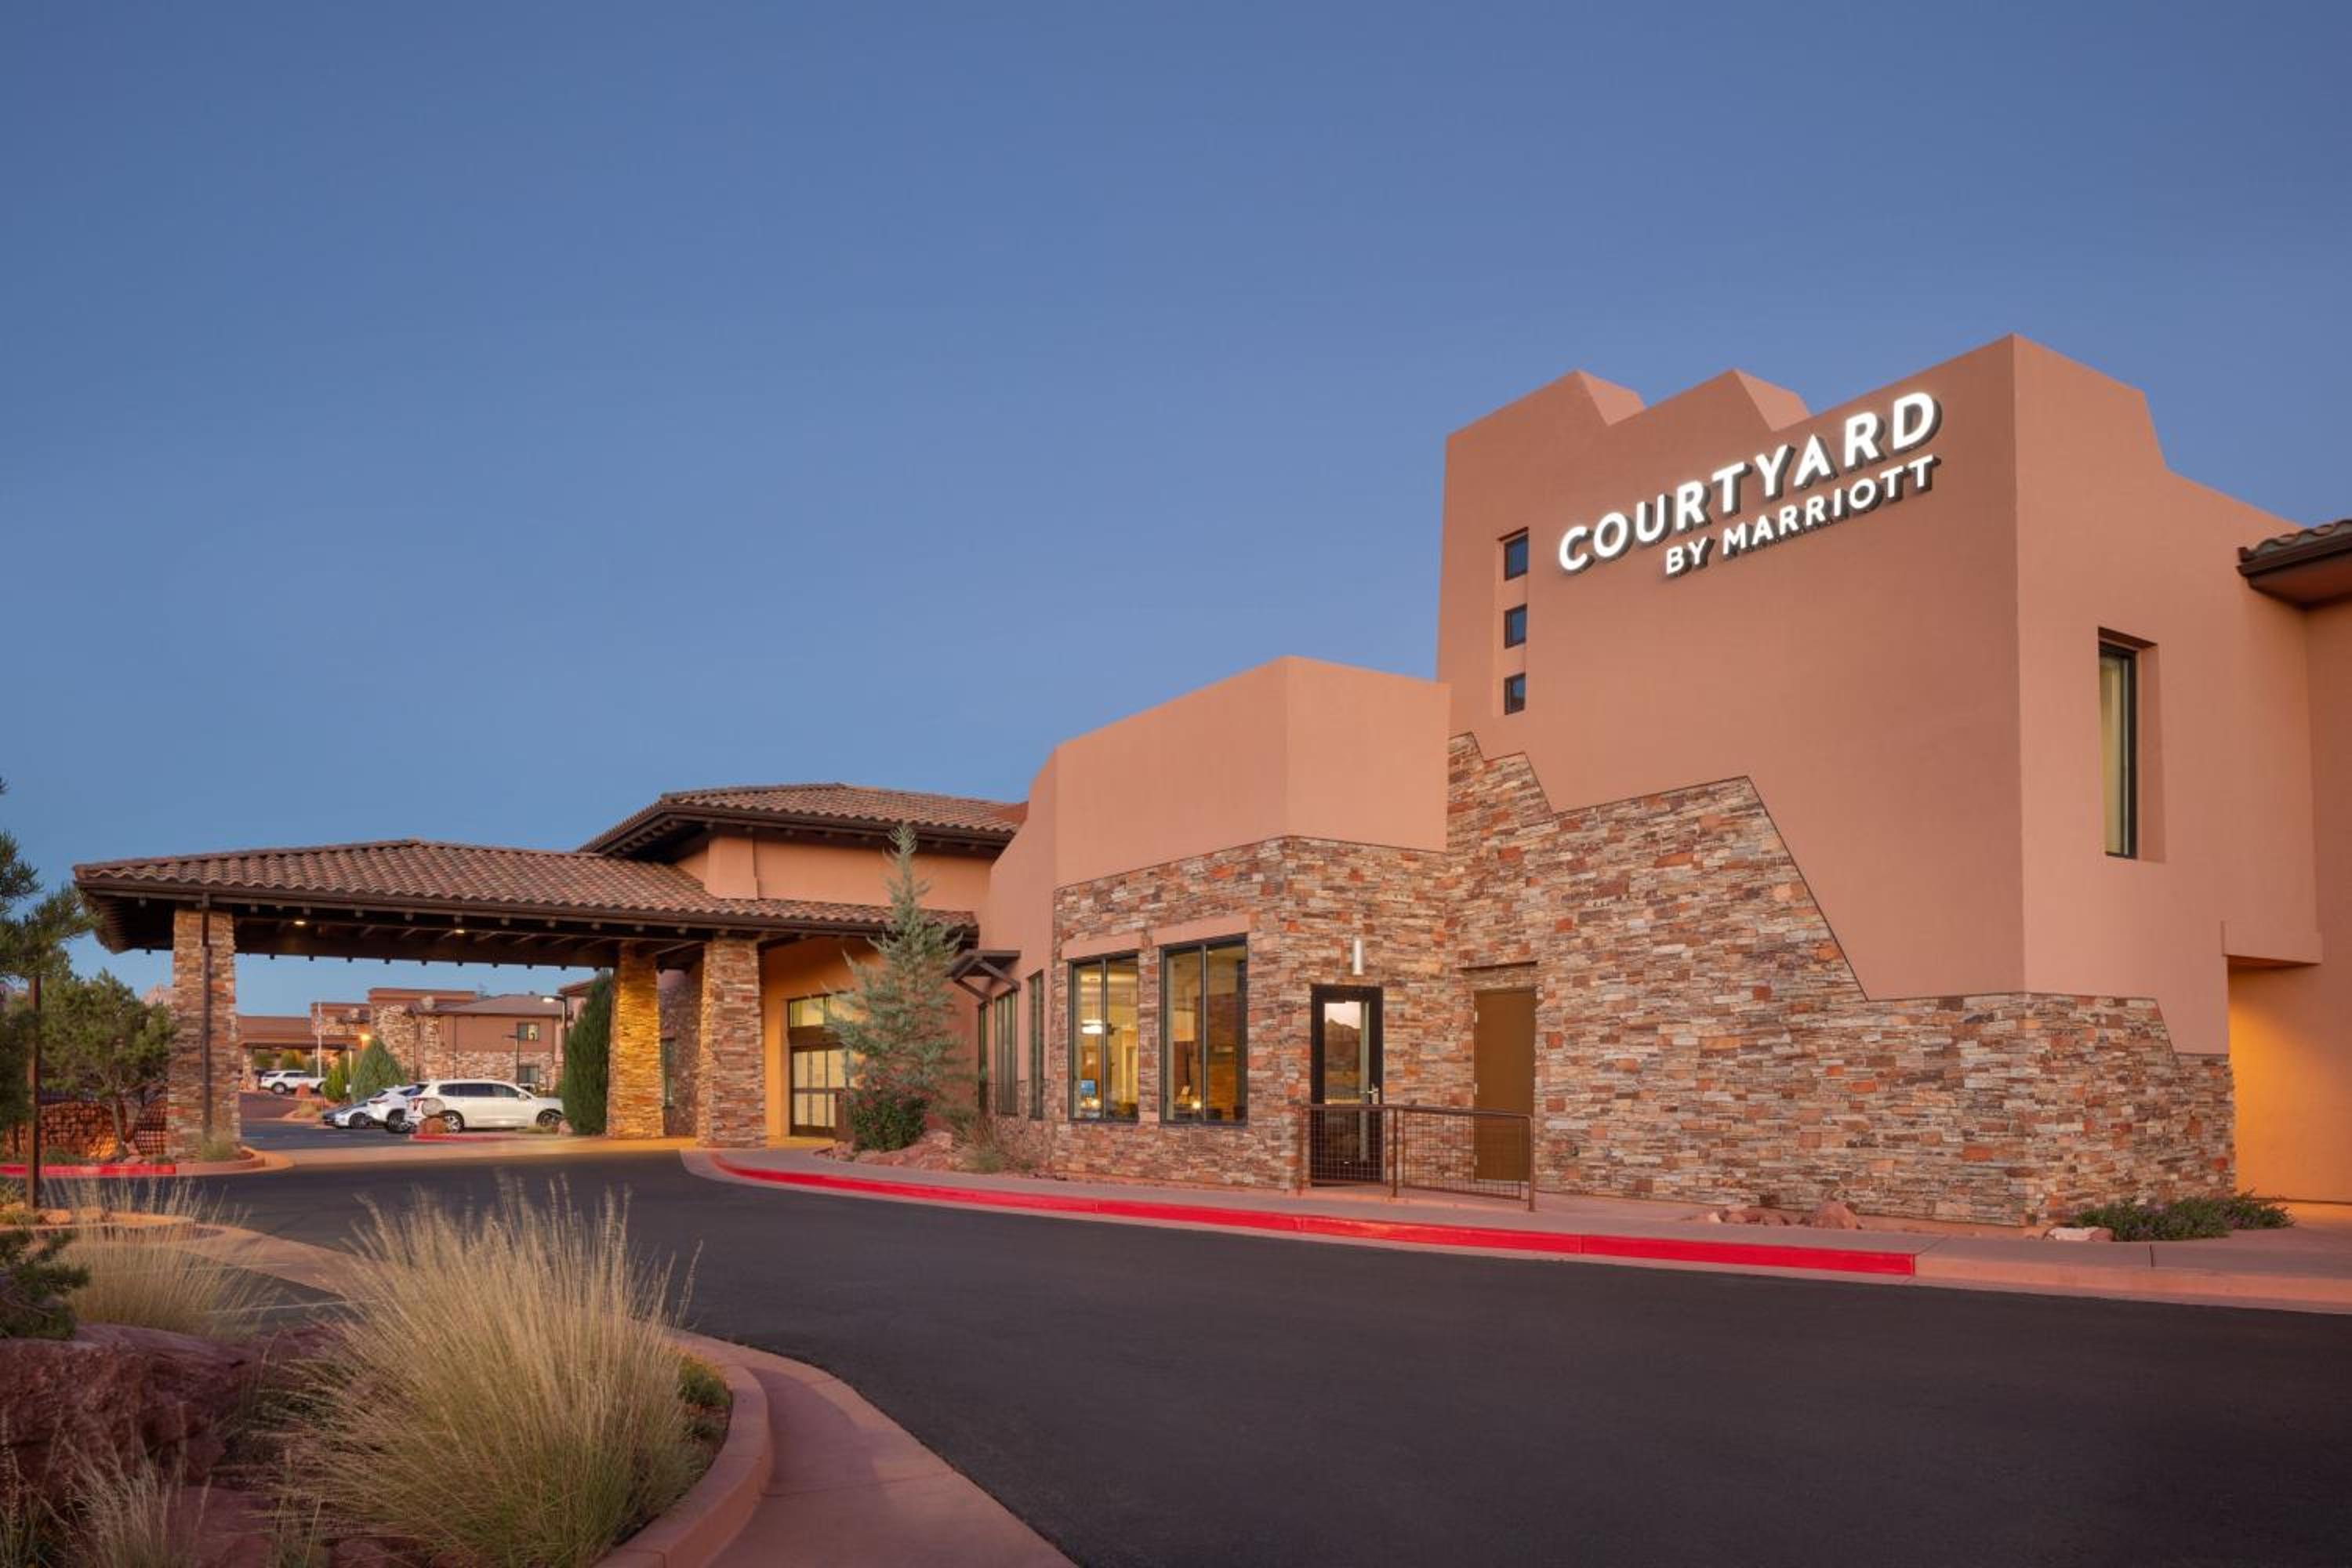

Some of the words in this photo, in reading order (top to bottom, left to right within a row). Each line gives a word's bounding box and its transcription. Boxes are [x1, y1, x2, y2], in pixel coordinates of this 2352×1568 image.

[1558, 391, 1940, 573] COURTYARD
[1664, 535, 1712, 576] BY
[1722, 454, 1937, 556] MARRIOTT
